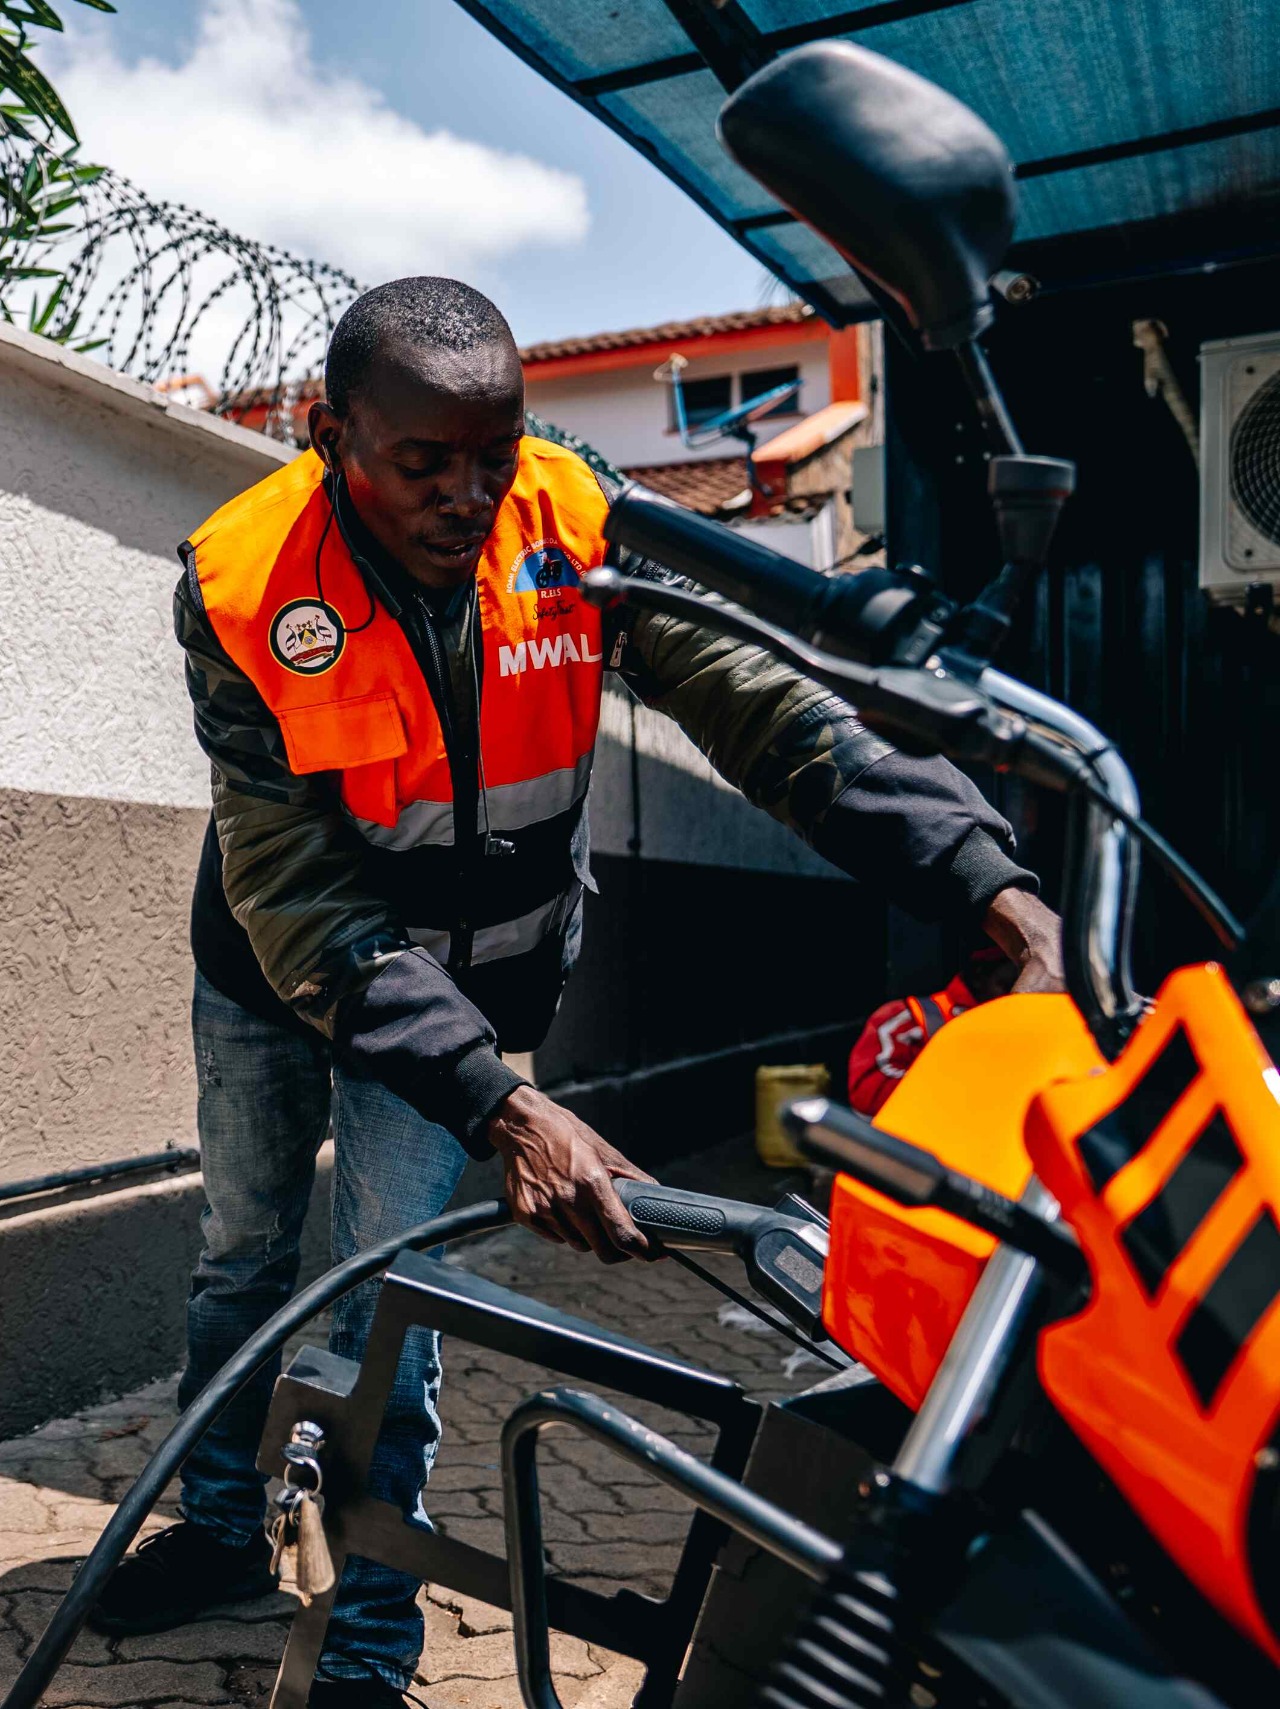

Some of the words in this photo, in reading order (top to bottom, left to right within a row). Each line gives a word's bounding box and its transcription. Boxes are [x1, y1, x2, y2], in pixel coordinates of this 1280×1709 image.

[506, 572, 515, 594] ROAM
[511, 545, 532, 572] ELECTRIC
[571, 558, 583, 570] LTD
